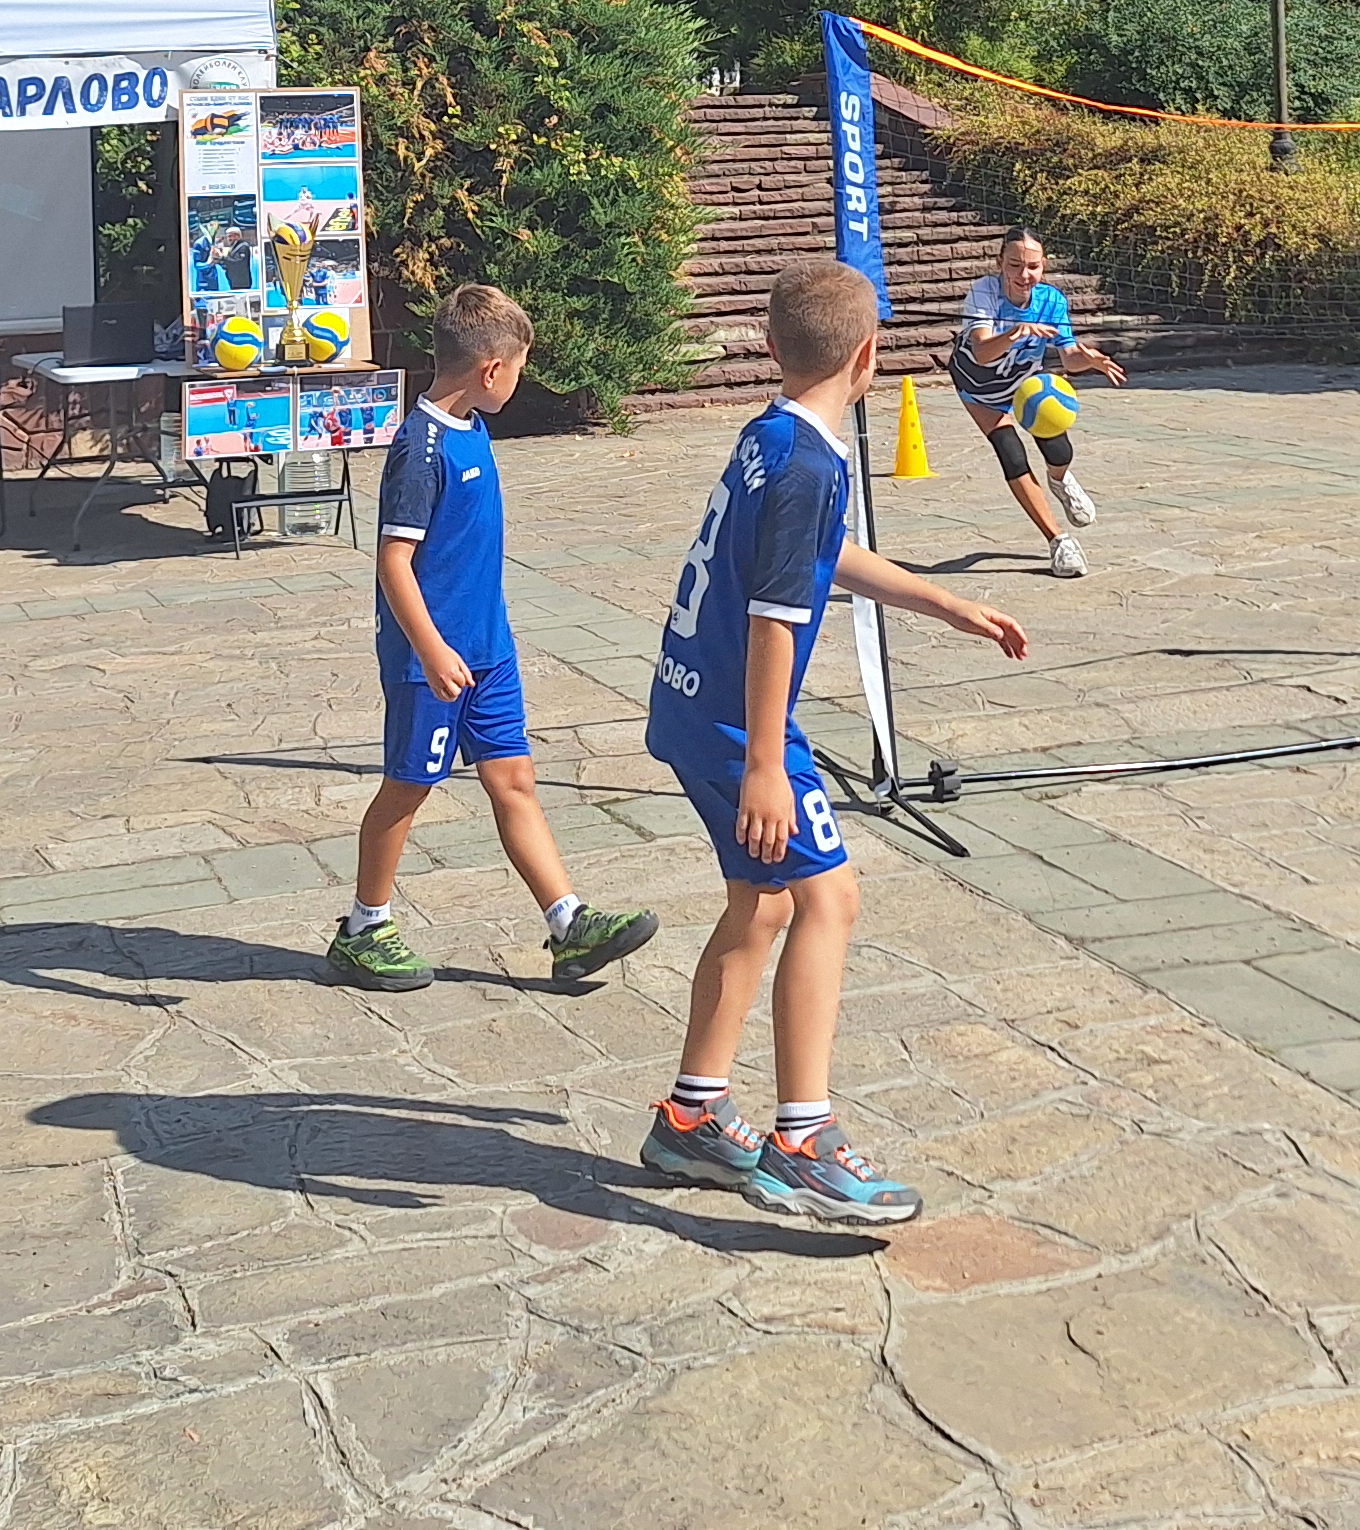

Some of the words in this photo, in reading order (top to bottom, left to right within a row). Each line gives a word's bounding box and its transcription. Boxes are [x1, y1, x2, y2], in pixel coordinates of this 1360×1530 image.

[839, 91, 868, 241] SPORT
[670, 480, 730, 639] 8
[426, 727, 450, 773] 9
[802, 788, 841, 852] 8
